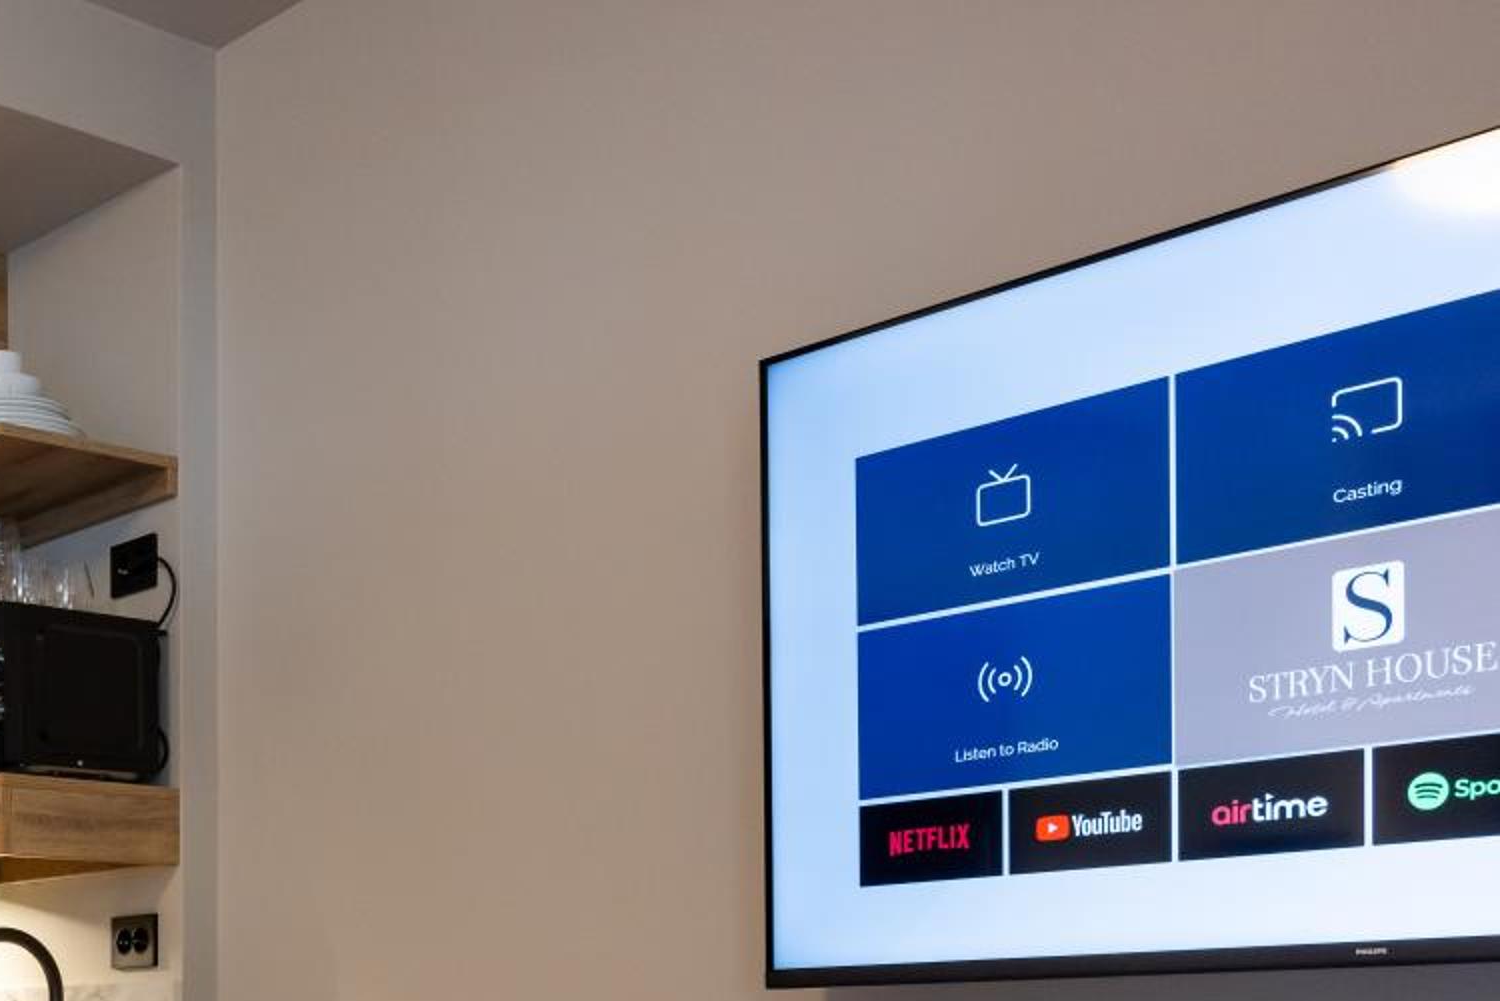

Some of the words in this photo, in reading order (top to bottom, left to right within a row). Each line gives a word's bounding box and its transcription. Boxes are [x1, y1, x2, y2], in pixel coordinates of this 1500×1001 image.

[1333, 480, 1402, 503] Casting
[969, 557, 1016, 577] Watch
[1018, 552, 1040, 567] TV
[1344, 568, 1392, 643] S
[1249, 661, 1353, 703] STRYN
[1367, 641, 1499, 687] HOUSE
[955, 747, 997, 763] Listen
[999, 744, 1015, 757] to
[1017, 737, 1059, 754] Radio
[1071, 809, 1143, 837] YouTube
[1211, 793, 1329, 825] airtime
[889, 824, 970, 856] NETFLIX
